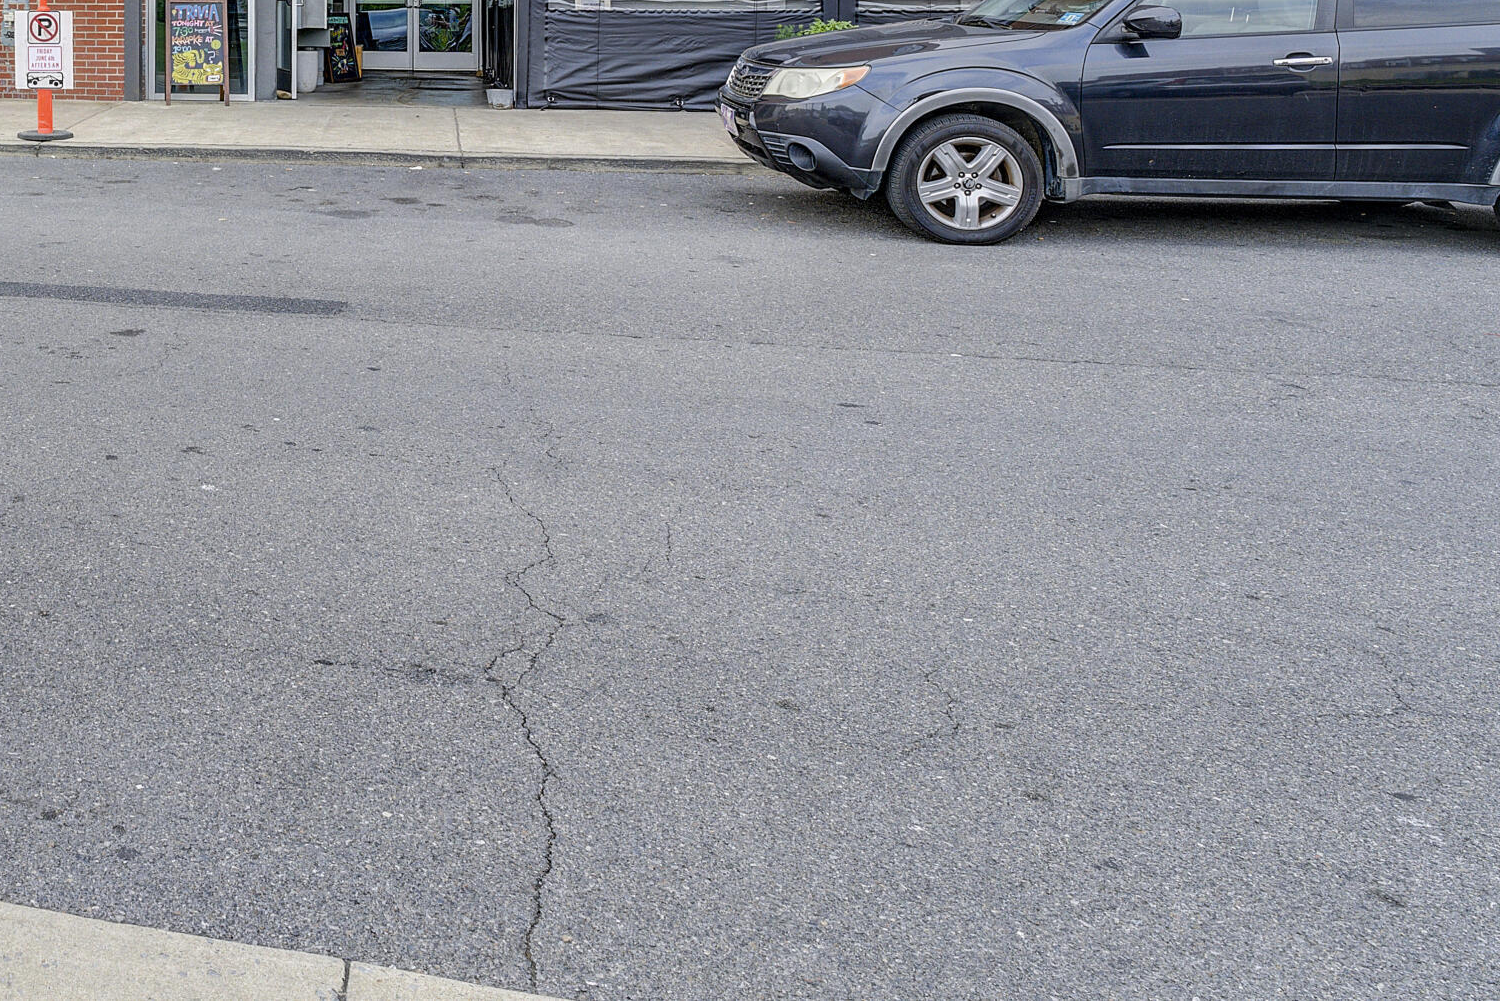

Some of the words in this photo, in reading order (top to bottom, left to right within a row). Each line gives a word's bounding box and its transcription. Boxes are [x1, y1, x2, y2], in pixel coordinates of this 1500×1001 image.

[175, 3, 220, 22] TRIVIA
[171, 19, 205, 27] TONIGHT
[172, 26, 194, 37] 7:30
